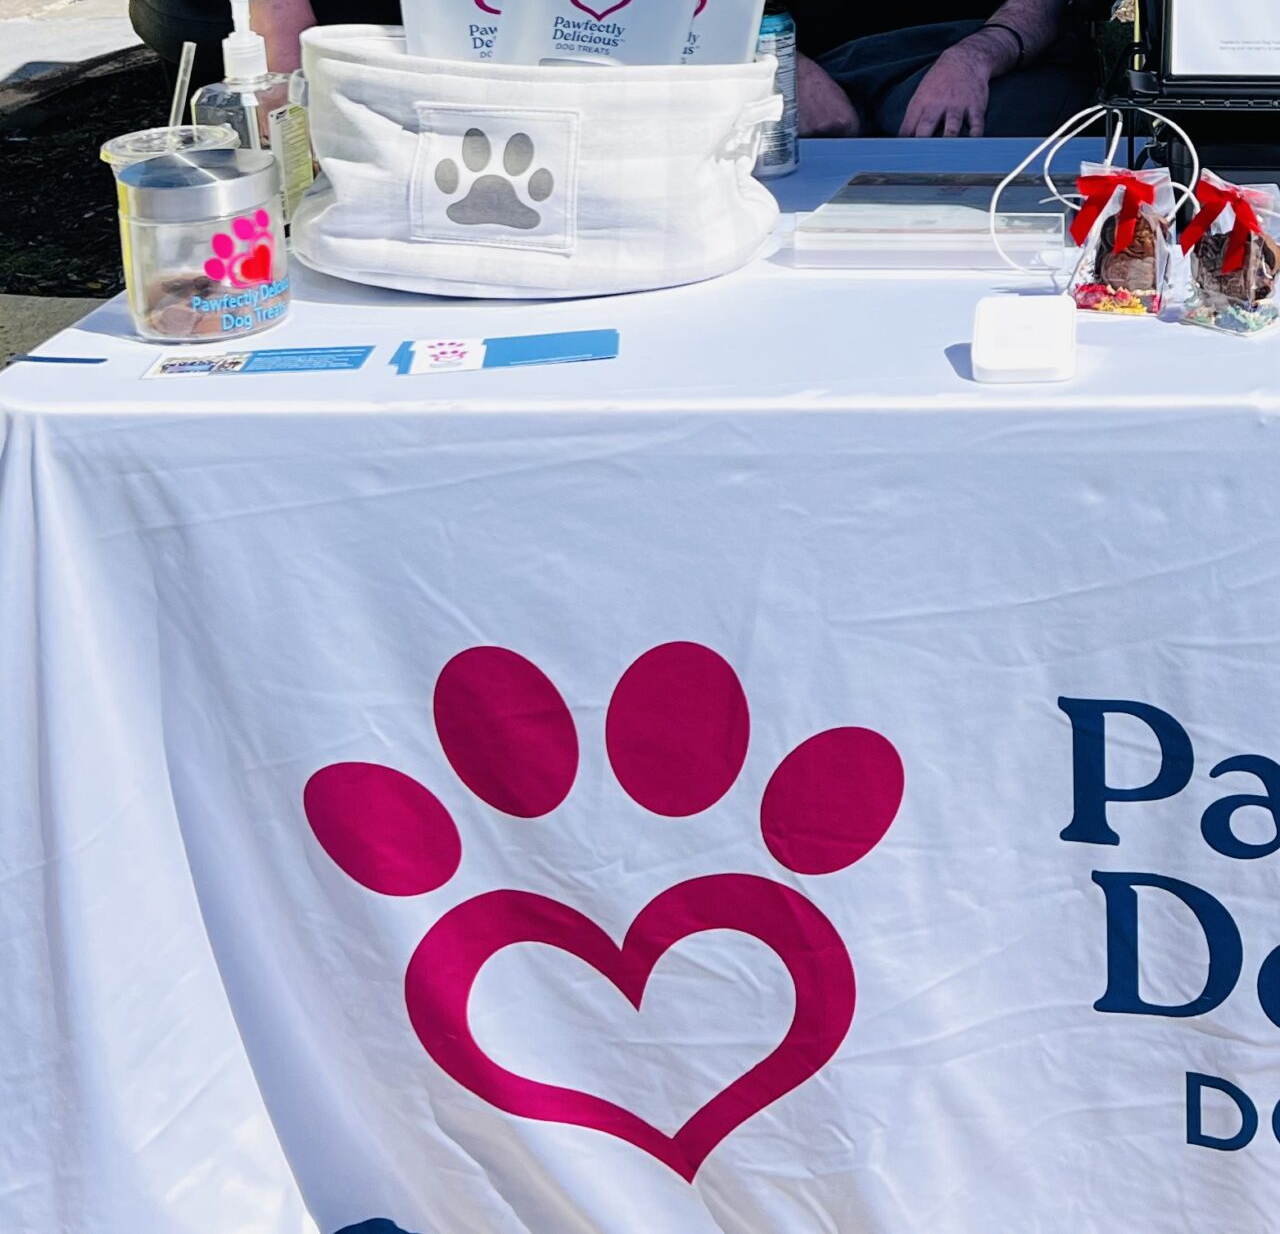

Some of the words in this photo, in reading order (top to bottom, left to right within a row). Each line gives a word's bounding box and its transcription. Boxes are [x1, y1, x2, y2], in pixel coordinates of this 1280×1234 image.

[554, 16, 626, 36] Pawfectly
[552, 28, 620, 47] Delicious
[555, 42, 575, 51] DOG
[577, 44, 611, 55] TREATS
[192, 289, 259, 313] Pawfectly
[221, 313, 253, 331] Dog
